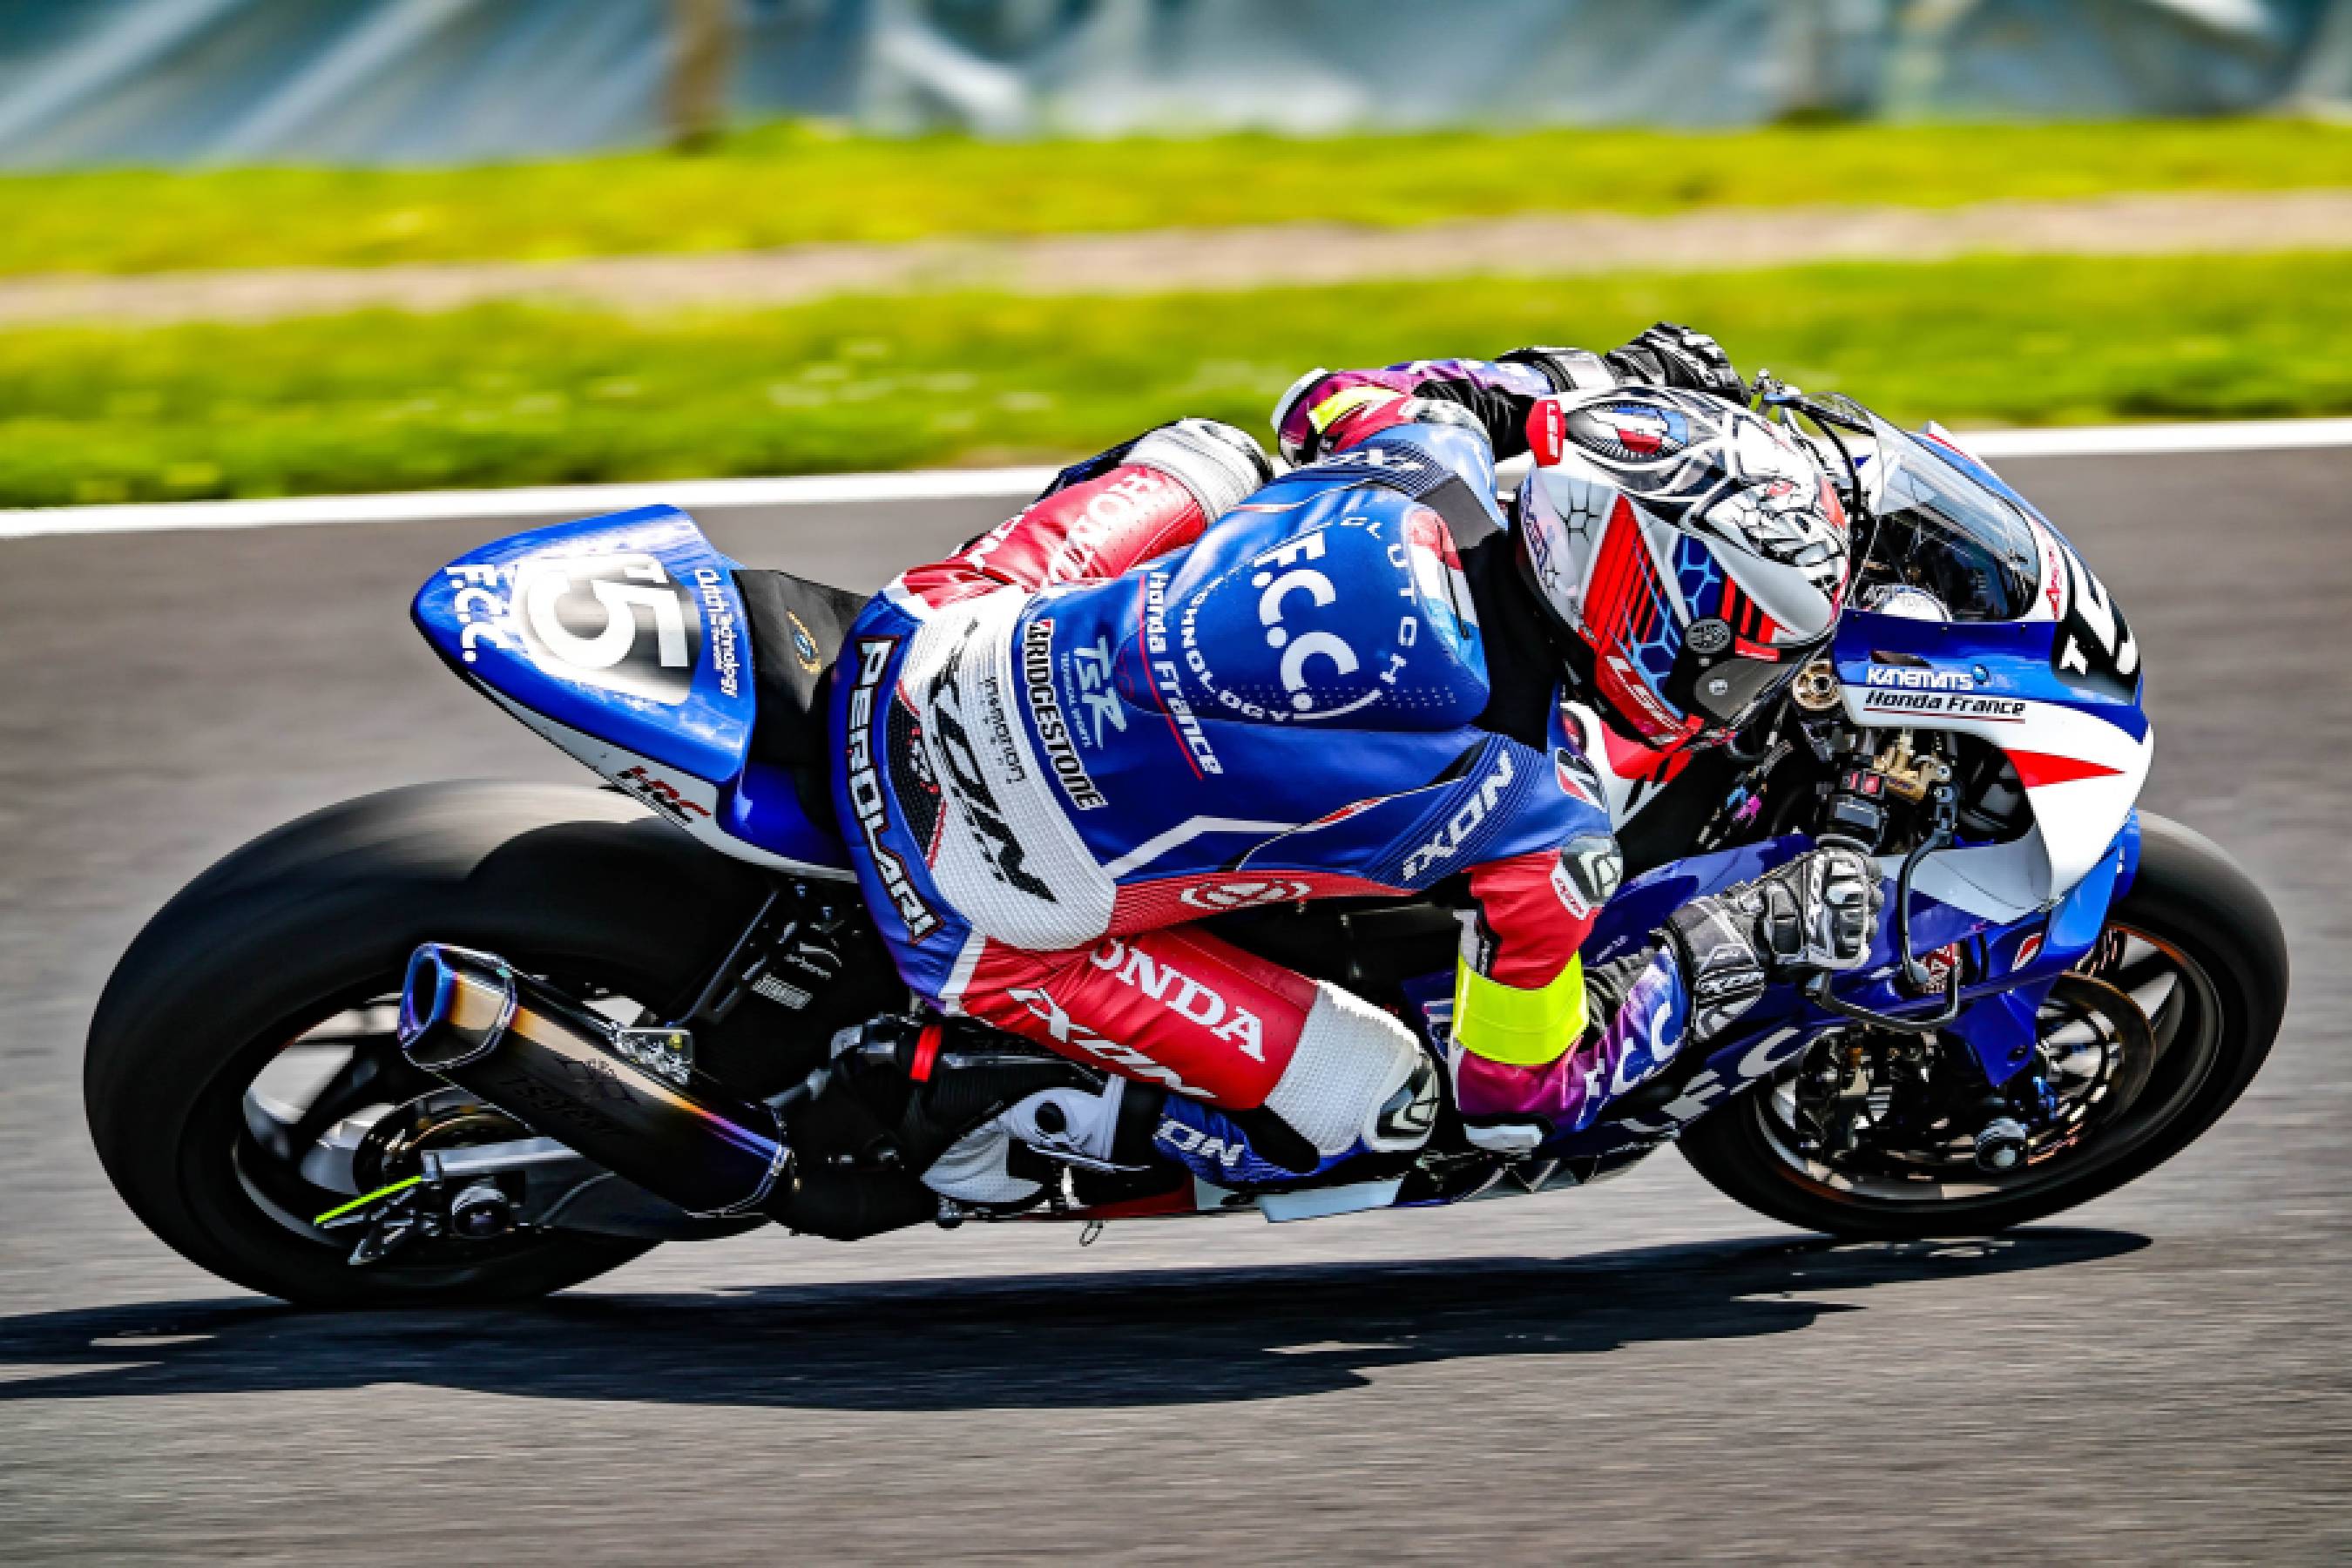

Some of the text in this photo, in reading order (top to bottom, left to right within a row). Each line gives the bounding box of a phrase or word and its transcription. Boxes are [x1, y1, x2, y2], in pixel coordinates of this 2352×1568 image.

[1024, 618, 1109, 811] BRIDGESTONE
[1147, 571, 1225, 774] Honda France
[1865, 689, 2026, 717] Honda France
[1089, 936, 1267, 1063] ONDA
